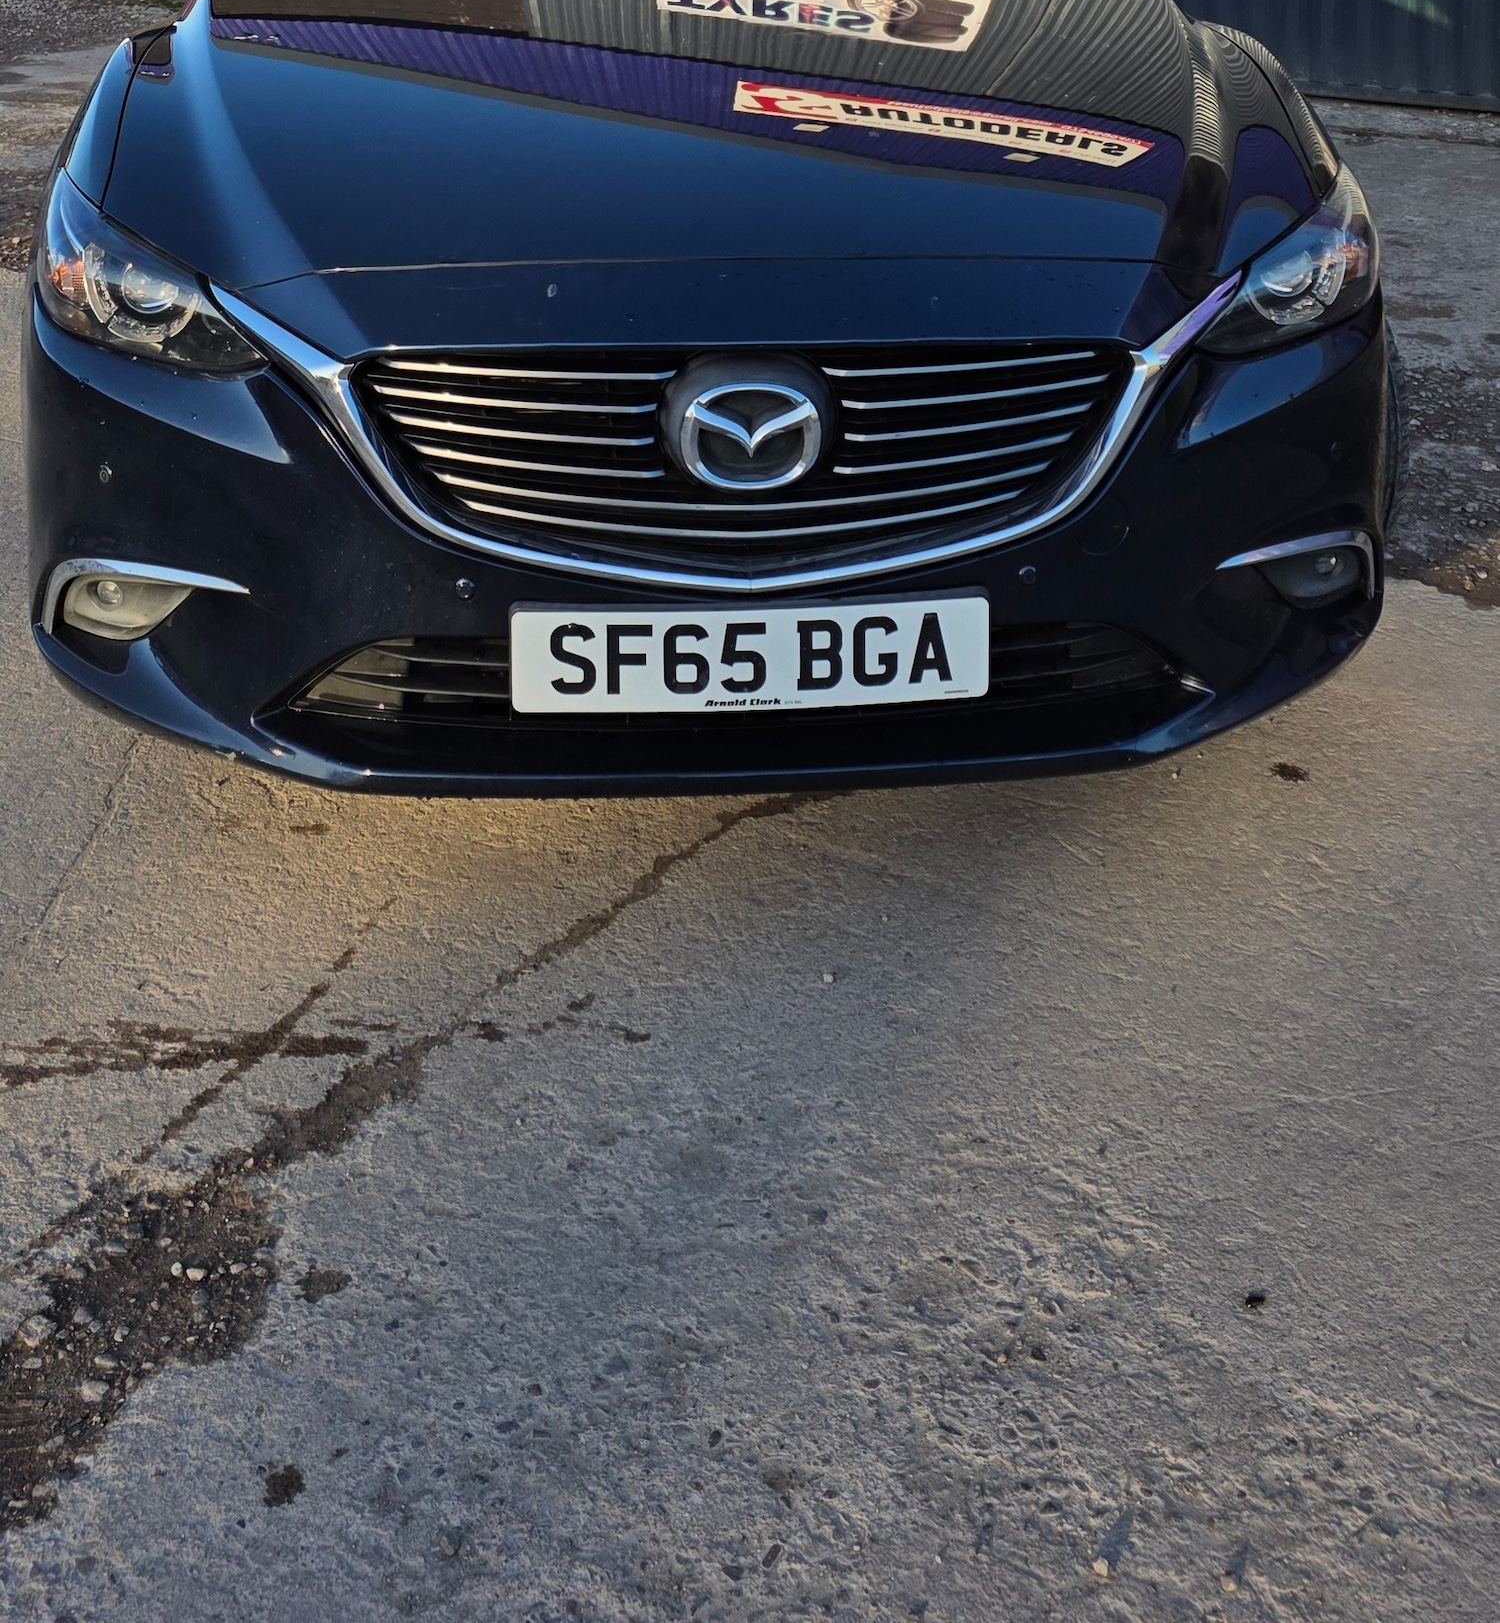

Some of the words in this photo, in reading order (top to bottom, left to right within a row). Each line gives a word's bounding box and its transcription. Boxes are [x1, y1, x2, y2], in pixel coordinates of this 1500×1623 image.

[550, 622, 767, 695] SF65
[797, 612, 953, 691] BGA
[704, 698, 746, 708] Arnold
[749, 697, 782, 707] Clark
